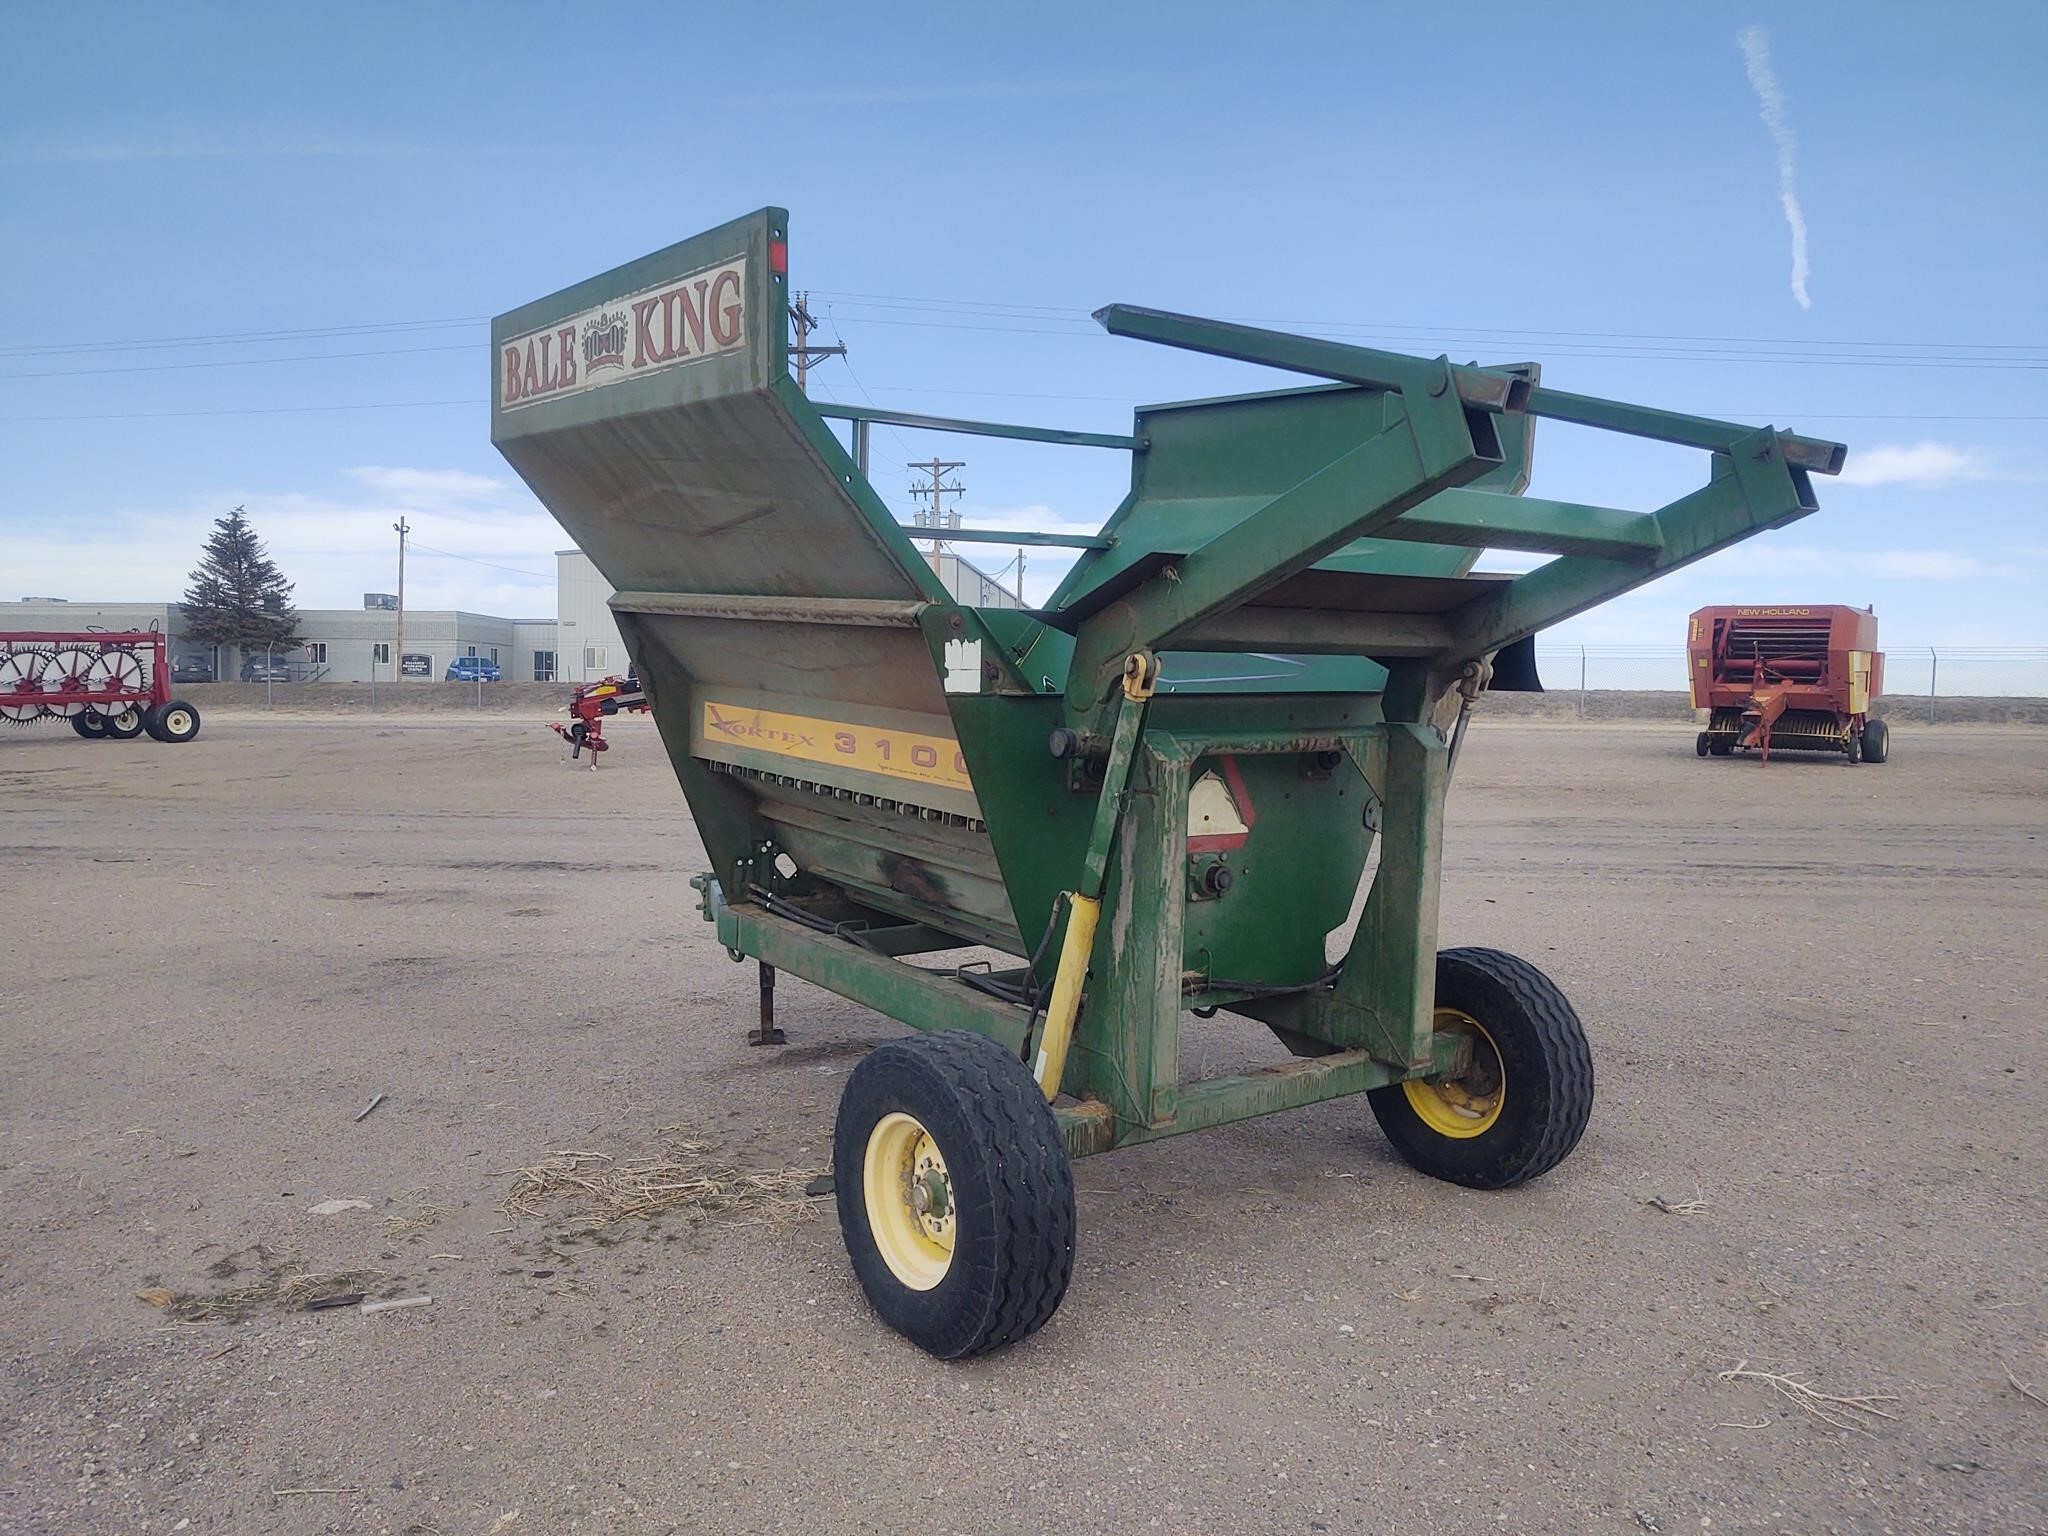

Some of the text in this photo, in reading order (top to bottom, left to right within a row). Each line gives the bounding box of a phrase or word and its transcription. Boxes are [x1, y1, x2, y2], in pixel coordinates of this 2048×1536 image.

[505, 270, 743, 401] BALE KING
[1737, 608, 1810, 616] NEW HOLLAND
